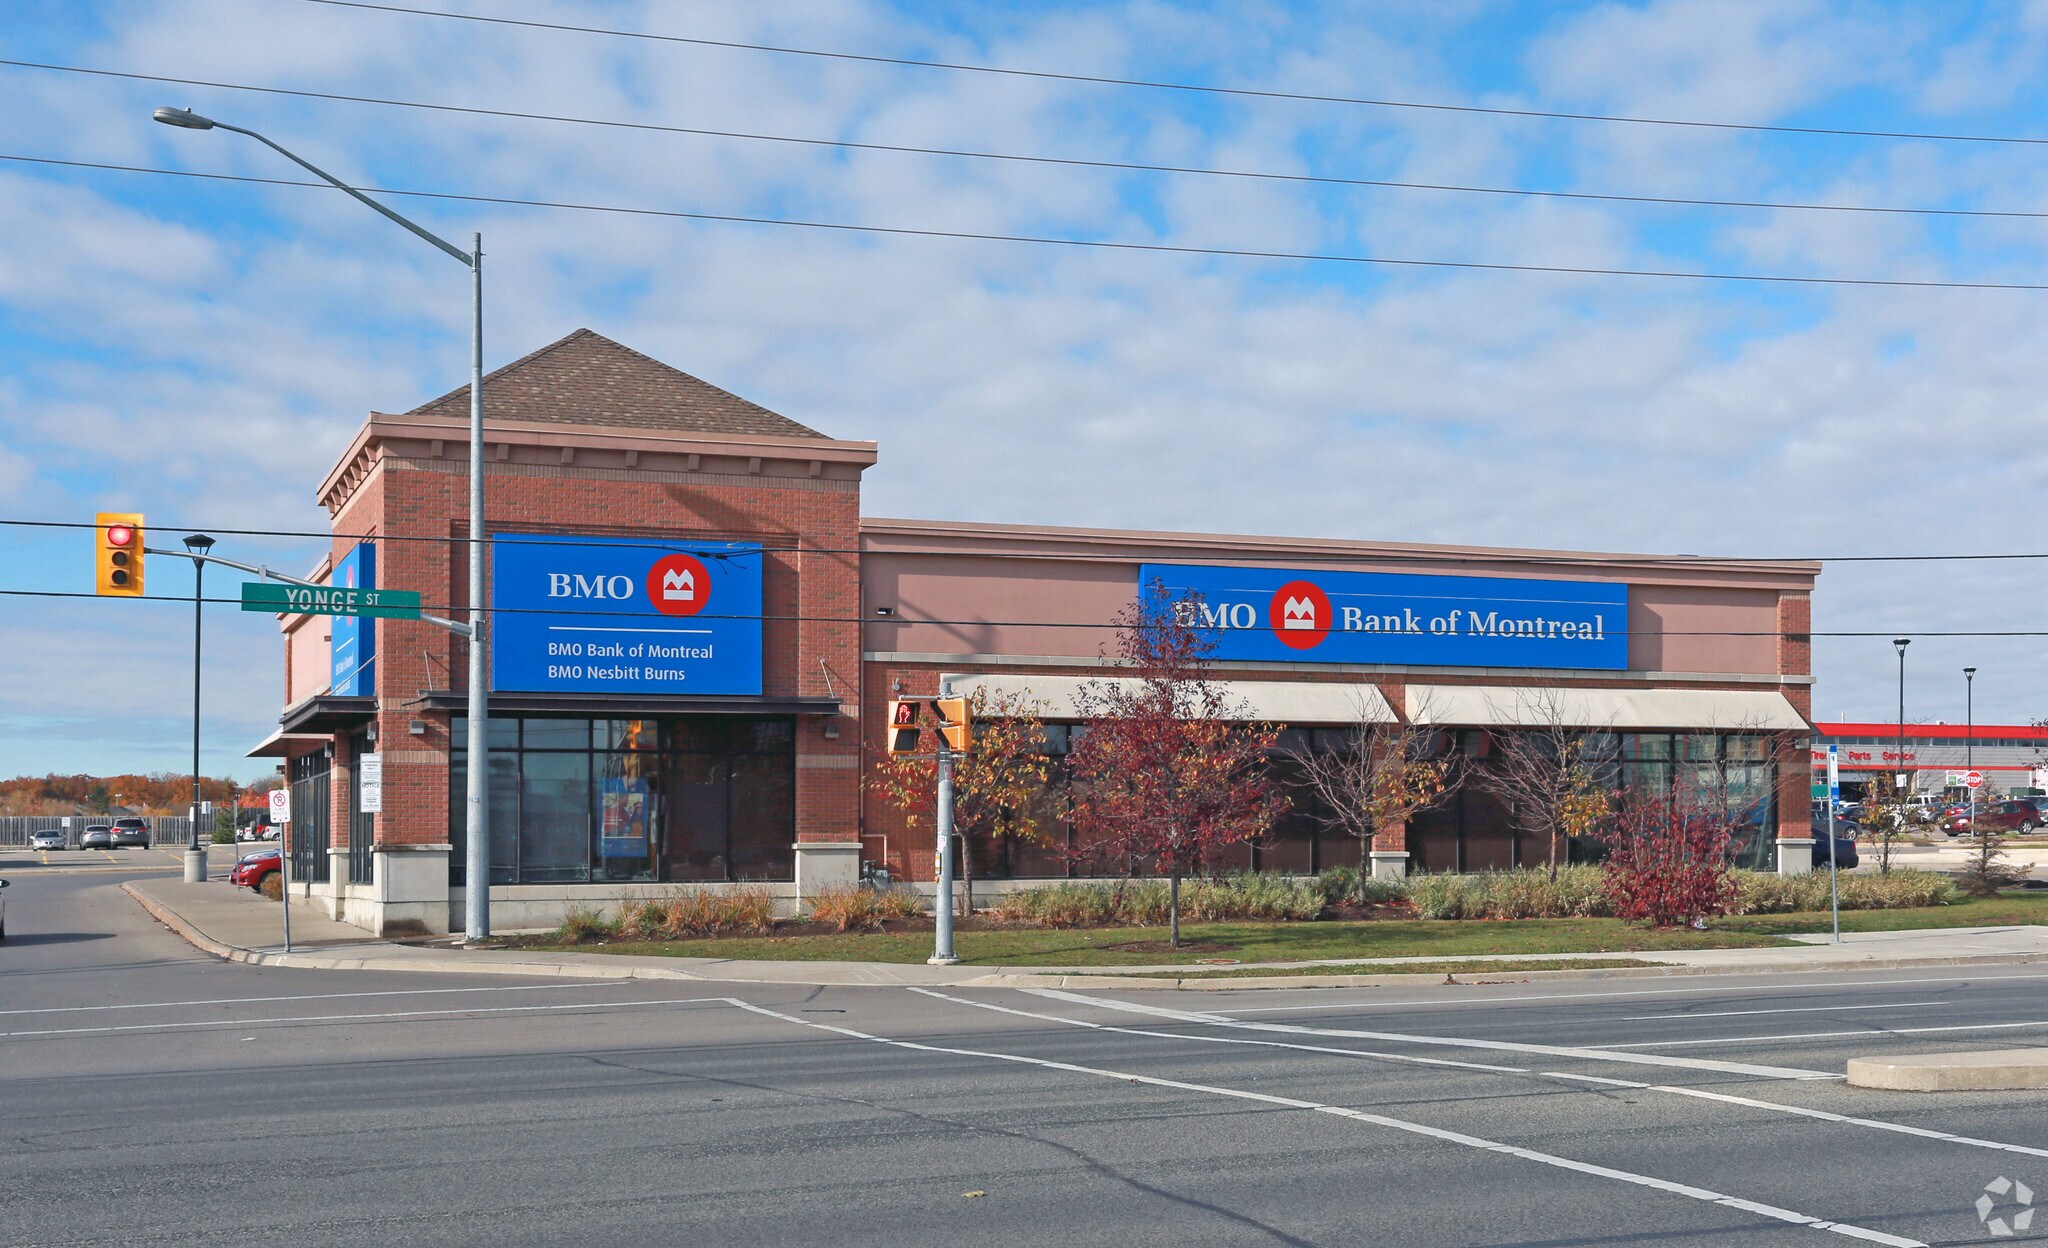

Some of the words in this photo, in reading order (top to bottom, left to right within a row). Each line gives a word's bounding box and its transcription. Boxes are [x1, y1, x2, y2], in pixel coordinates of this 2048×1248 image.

[548, 573, 634, 599] BMO
[285, 588, 358, 613] YONGE
[366, 593, 380, 606] ST
[1341, 606, 1423, 635] Bank
[1430, 609, 1461, 636] of
[1467, 611, 1605, 641] Montreal
[548, 643, 582, 657] BMO
[588, 643, 624, 658] Bank
[629, 644, 643, 658] of
[648, 644, 713, 659] Montreal
[548, 665, 582, 679] BMO
[587, 665, 640, 680] Nesbitt
[645, 667, 685, 681] Burns
[1848, 751, 1871, 760] Parts
[1966, 776, 1981, 784] STOP
